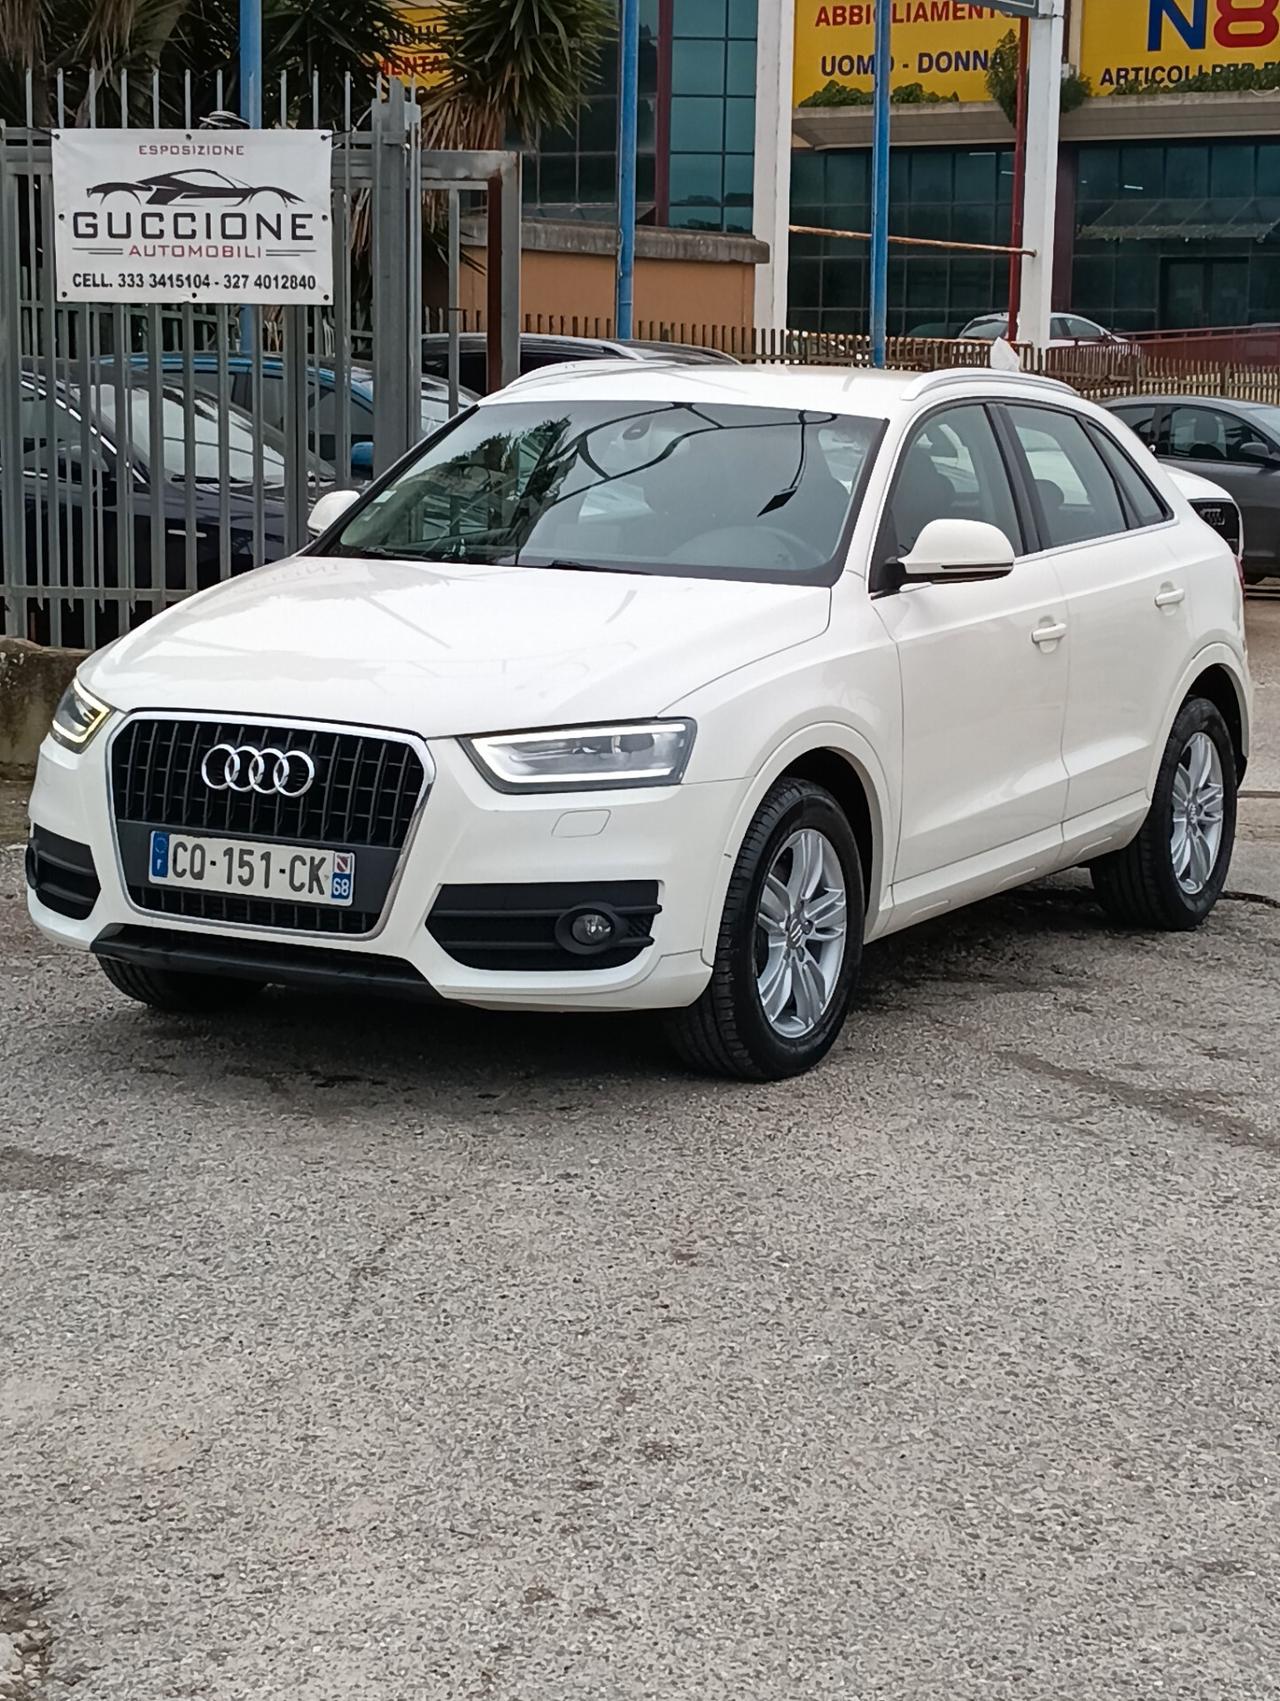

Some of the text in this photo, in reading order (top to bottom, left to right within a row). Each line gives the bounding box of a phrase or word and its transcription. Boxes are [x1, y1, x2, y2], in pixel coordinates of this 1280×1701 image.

[815, 0, 1016, 27] ABBILIAMEN
[821, 54, 894, 77] UOM
[917, 50, 1006, 74] DONN
[139, 145, 245, 156] ESPOSIZIONE
[73, 211, 314, 241] GUCCIONE
[128, 244, 262, 259] AUTOMOBILI
[72, 273, 114, 288] CELL.
[118, 273, 145, 288] 333
[149, 273, 211, 289] 3415104
[223, 274, 250, 289] 327
[254, 274, 316, 290] 4012840
[332, 877, 350, 896] 68
